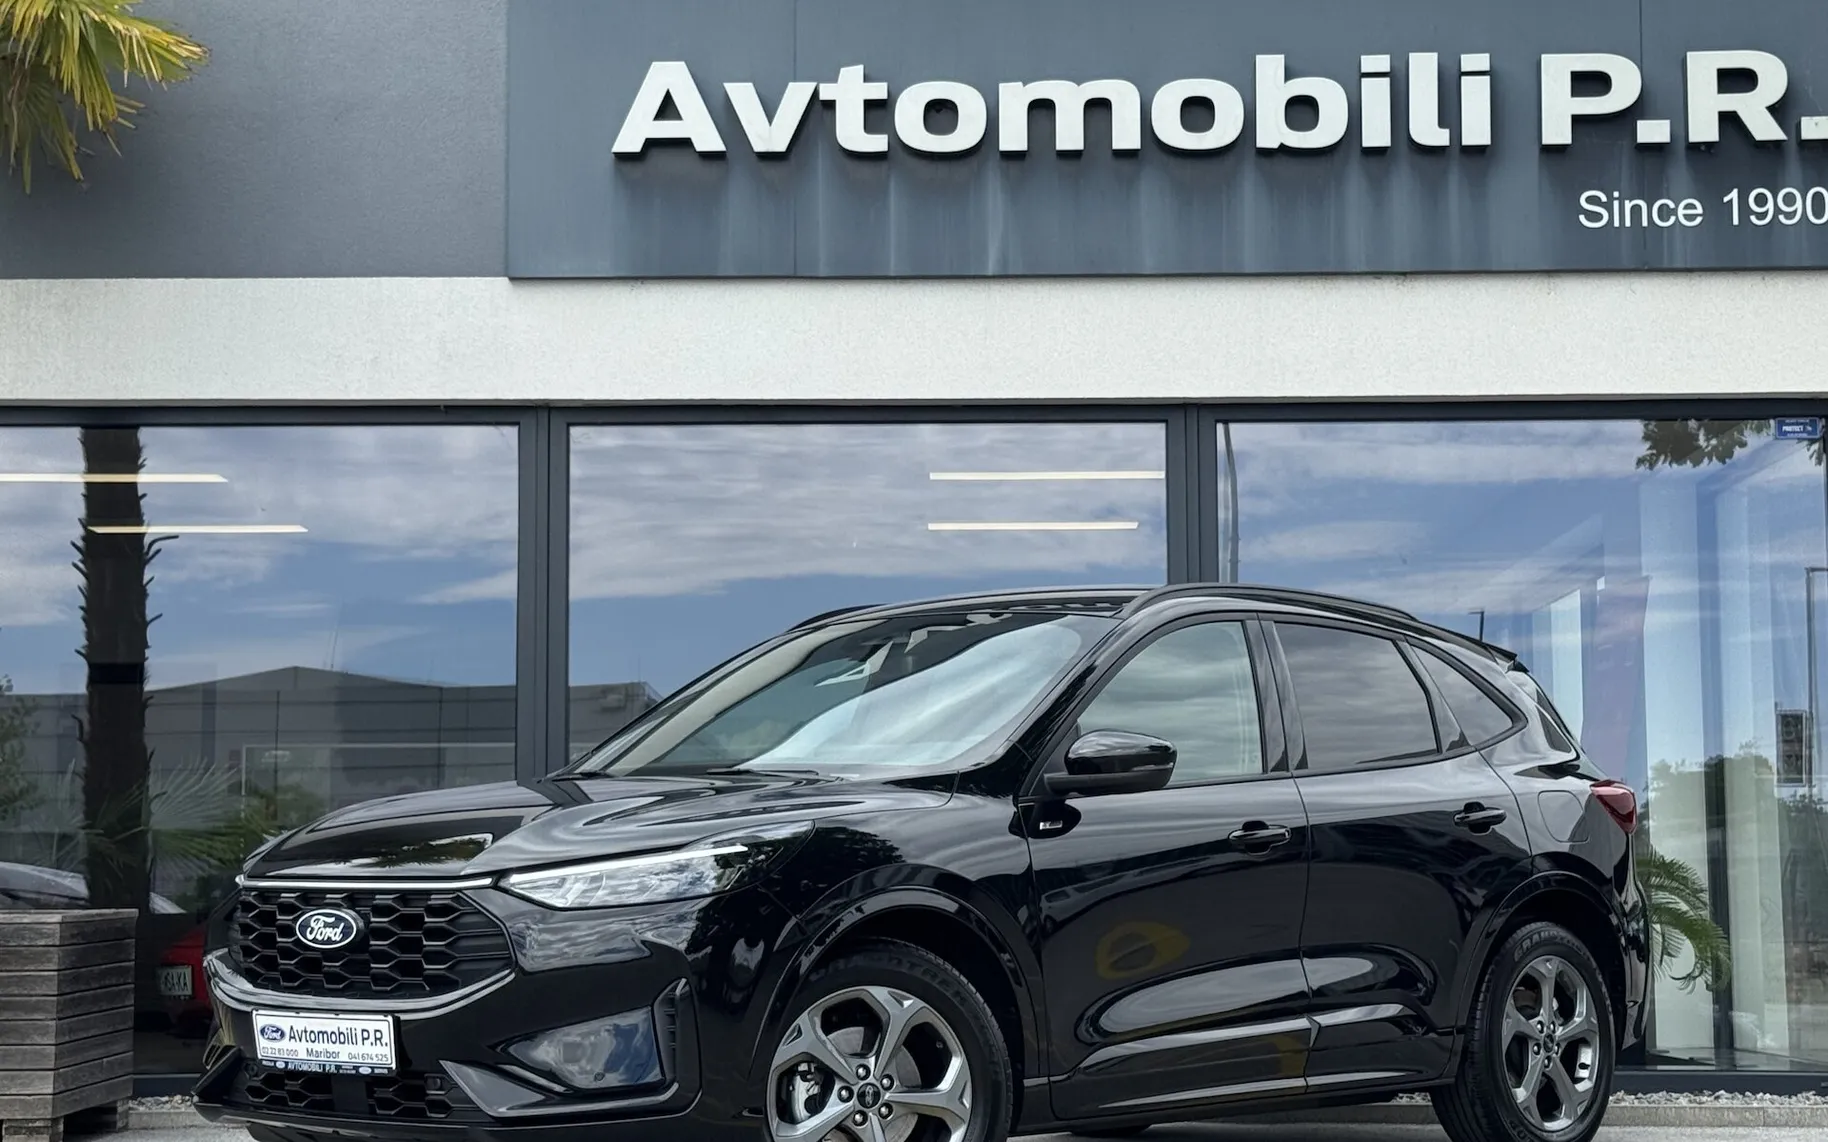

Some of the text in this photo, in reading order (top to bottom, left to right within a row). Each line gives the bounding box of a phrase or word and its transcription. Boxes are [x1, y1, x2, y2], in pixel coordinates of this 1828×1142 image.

[611, 50, 1828, 153] Avtomobili P.R.
[1578, 187, 1828, 228] Since 1990
[306, 915, 345, 941] Ford
[288, 1025, 358, 1046] Avtomobili
[361, 1028, 388, 1047] P.R.
[306, 1047, 340, 1060] Maribor
